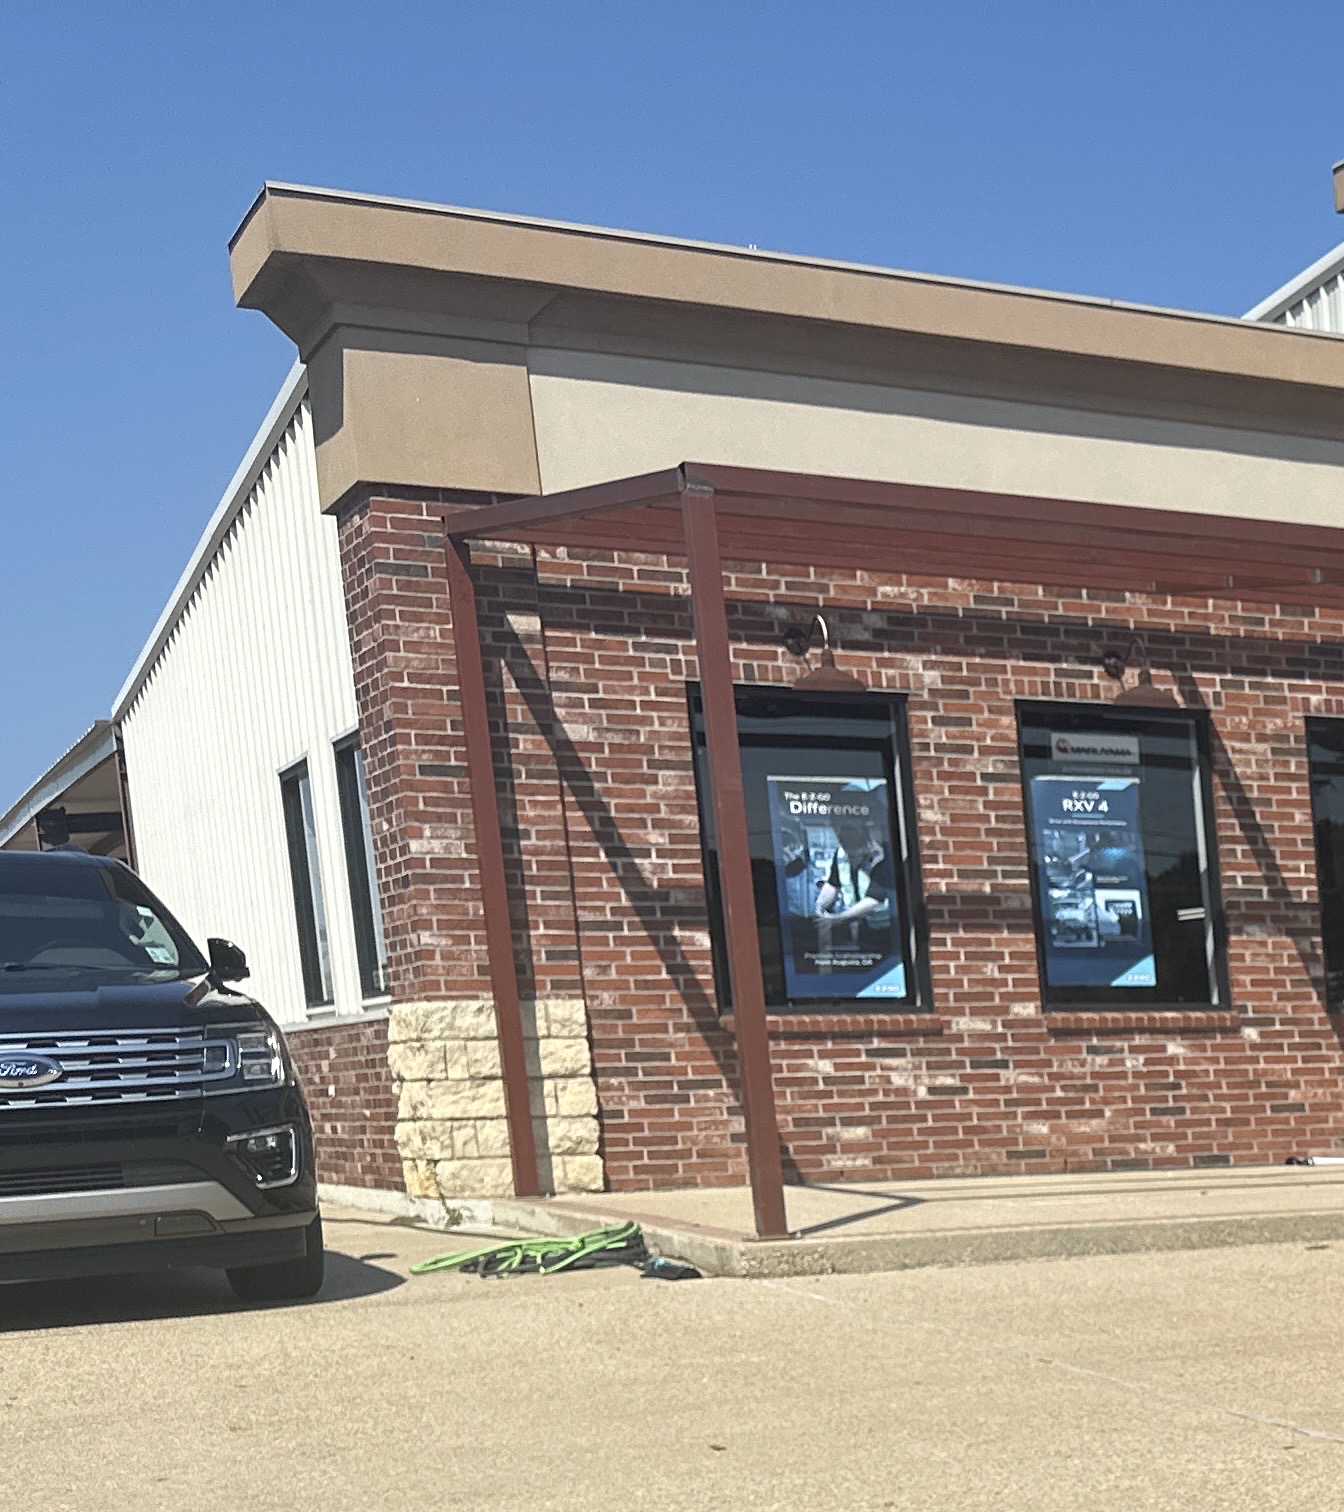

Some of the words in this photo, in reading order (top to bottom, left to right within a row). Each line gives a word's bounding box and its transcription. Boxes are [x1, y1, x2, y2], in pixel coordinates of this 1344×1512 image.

[789, 801, 870, 815] Difference
[1062, 799, 1095, 812] RXV
[1098, 800, 1109, 813] 4
